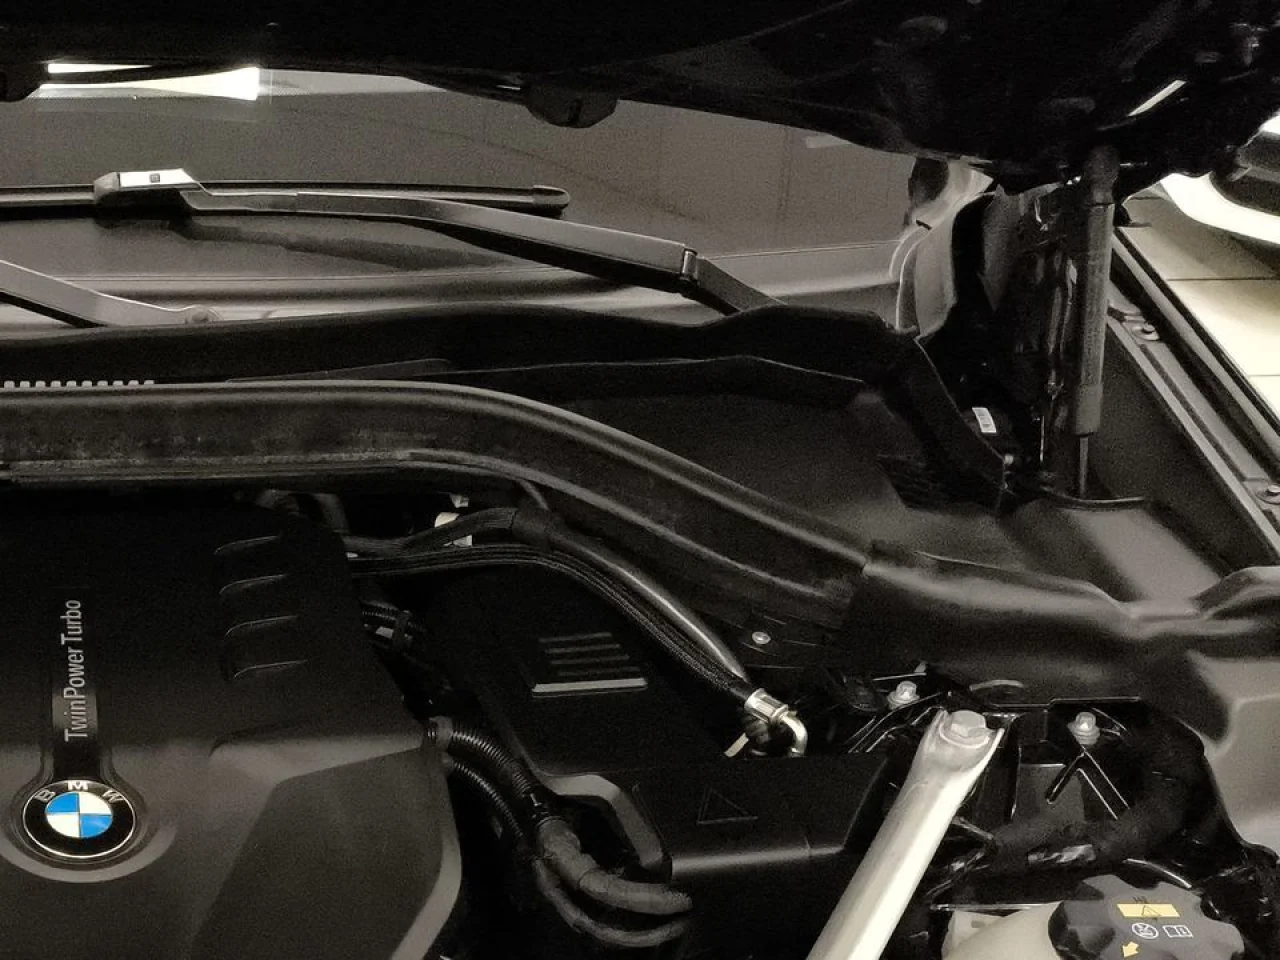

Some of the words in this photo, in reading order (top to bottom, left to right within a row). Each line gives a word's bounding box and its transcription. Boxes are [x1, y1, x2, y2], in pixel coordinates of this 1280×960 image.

[60, 600, 82, 645] Turbo
[63, 646, 88, 742] TwinPower
[34, 780, 125, 802] BMW
